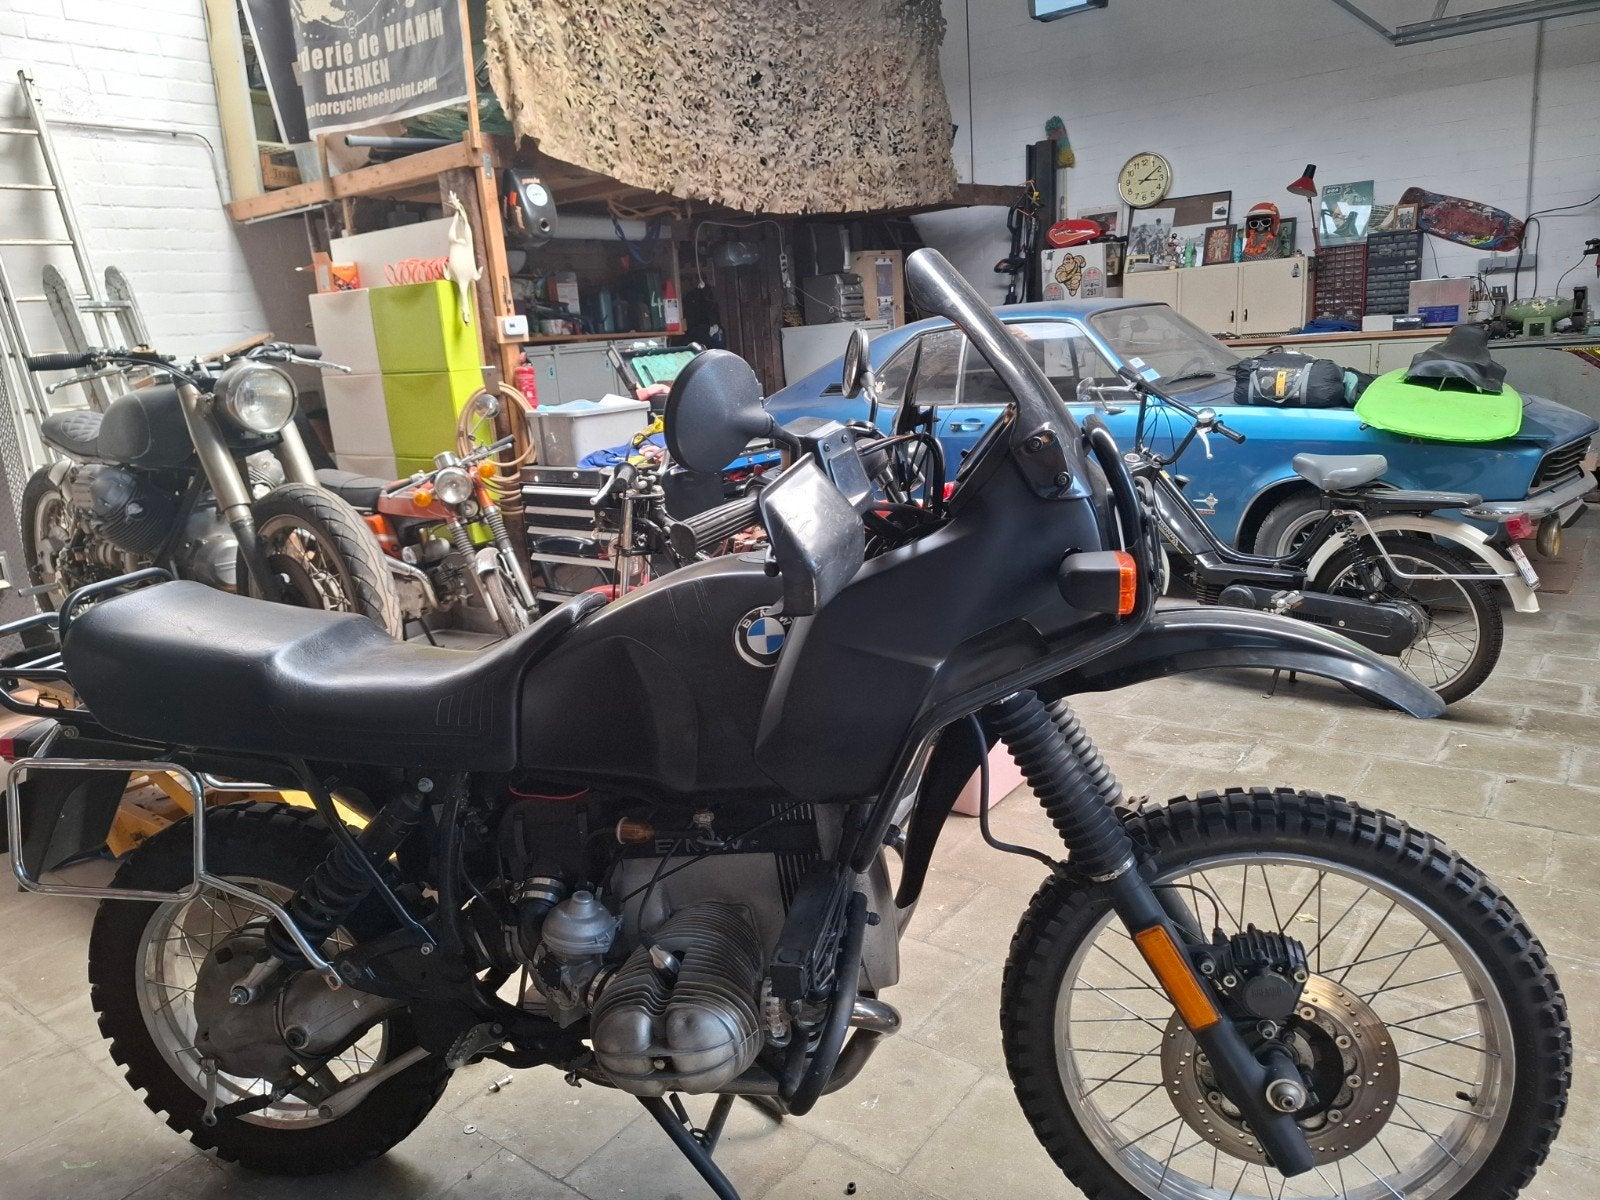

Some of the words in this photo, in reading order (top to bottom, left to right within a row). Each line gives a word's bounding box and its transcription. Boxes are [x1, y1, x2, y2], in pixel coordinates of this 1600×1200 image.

[297, 41, 354, 73] derie
[358, 33, 380, 60] de
[384, 7, 444, 52] VLAMM
[325, 58, 391, 95] KLERKEN
